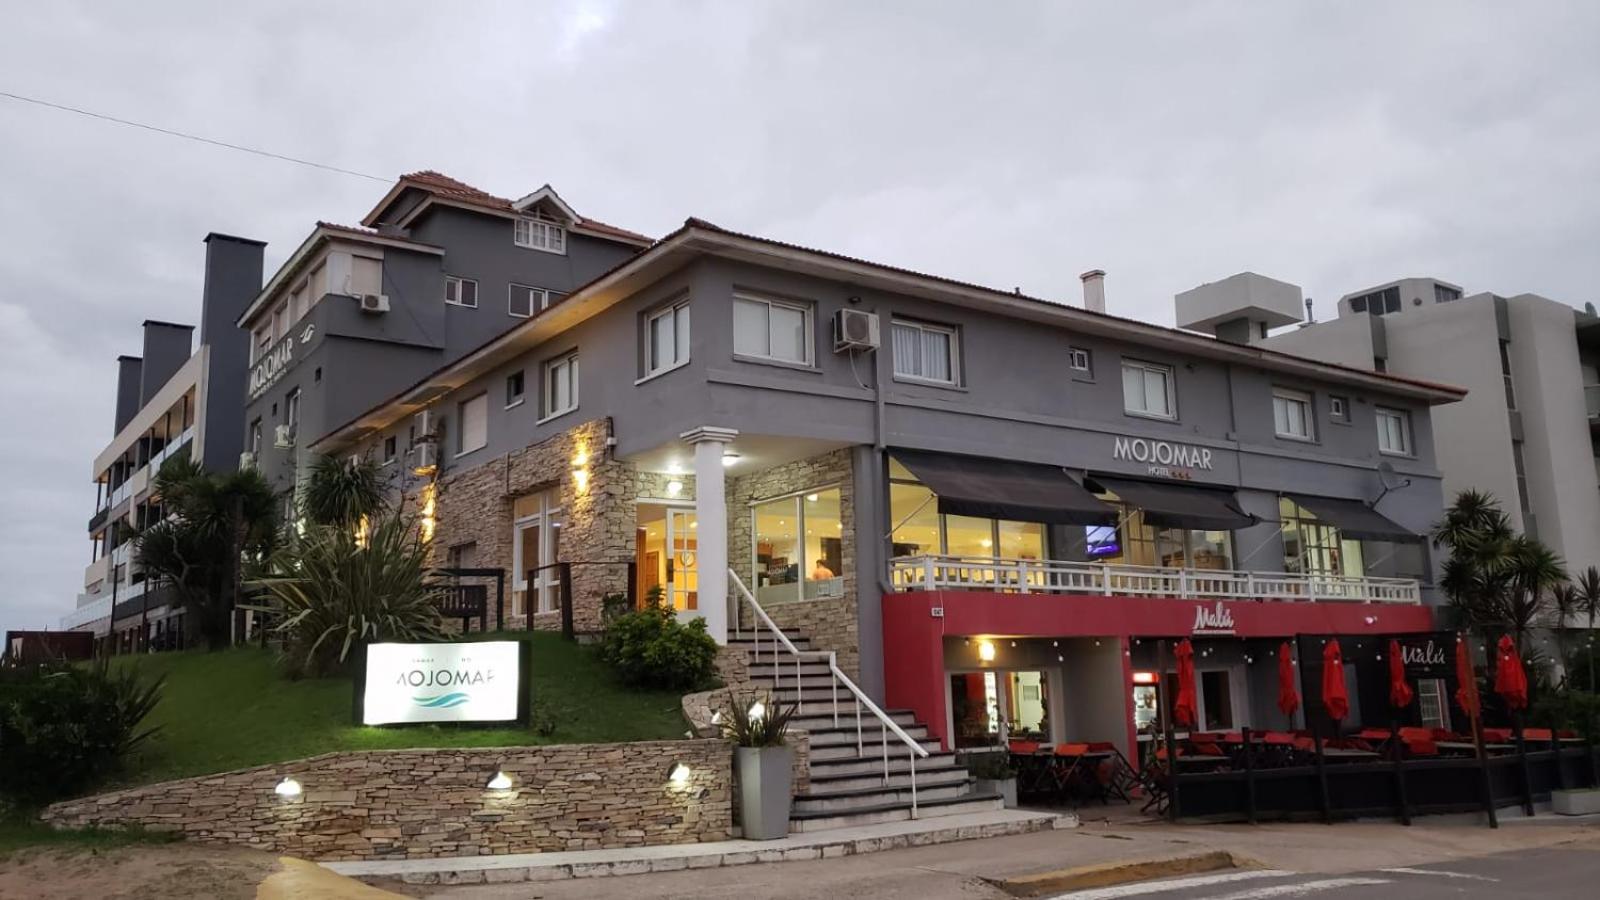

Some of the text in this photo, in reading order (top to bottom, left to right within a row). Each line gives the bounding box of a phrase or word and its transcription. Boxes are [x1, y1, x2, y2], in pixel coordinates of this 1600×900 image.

[247, 337, 294, 396] MOJOMAR
[1113, 437, 1212, 470] MOJOMAR
[1148, 466, 1169, 477] HOTEL
[1192, 601, 1234, 629] Malú
